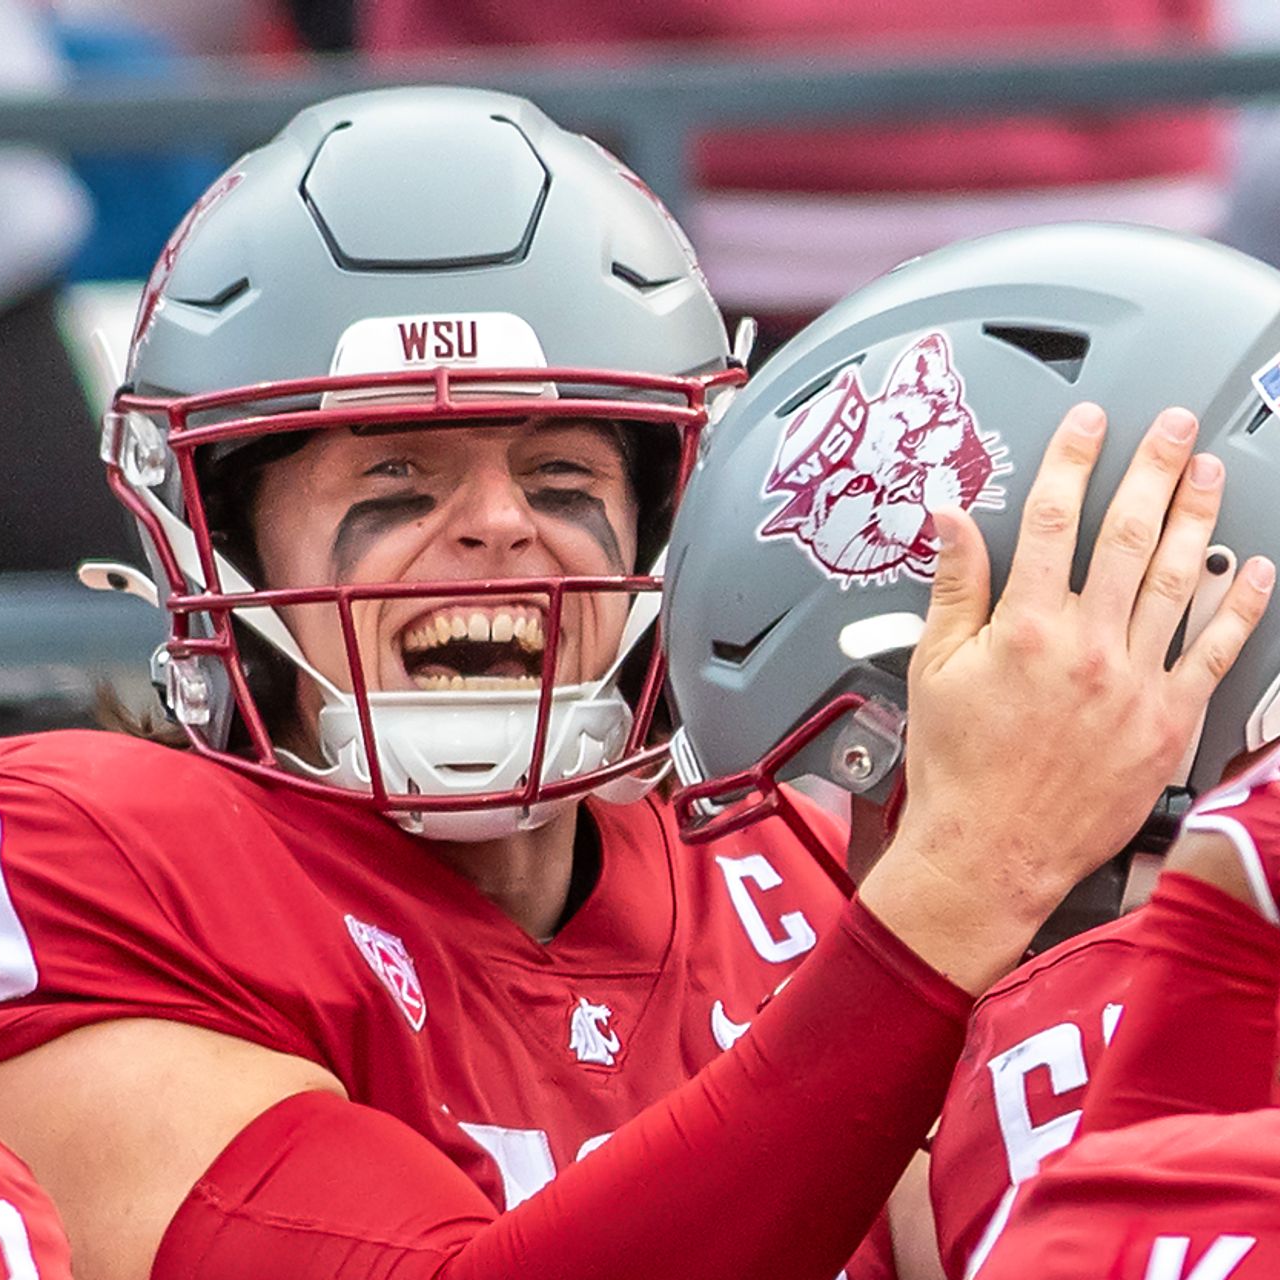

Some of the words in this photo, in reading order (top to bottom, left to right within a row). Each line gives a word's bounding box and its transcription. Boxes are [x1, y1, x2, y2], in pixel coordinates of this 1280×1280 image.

[397, 320, 478, 361] WSU
[782, 395, 866, 486] WSC
[714, 853, 817, 963] C
